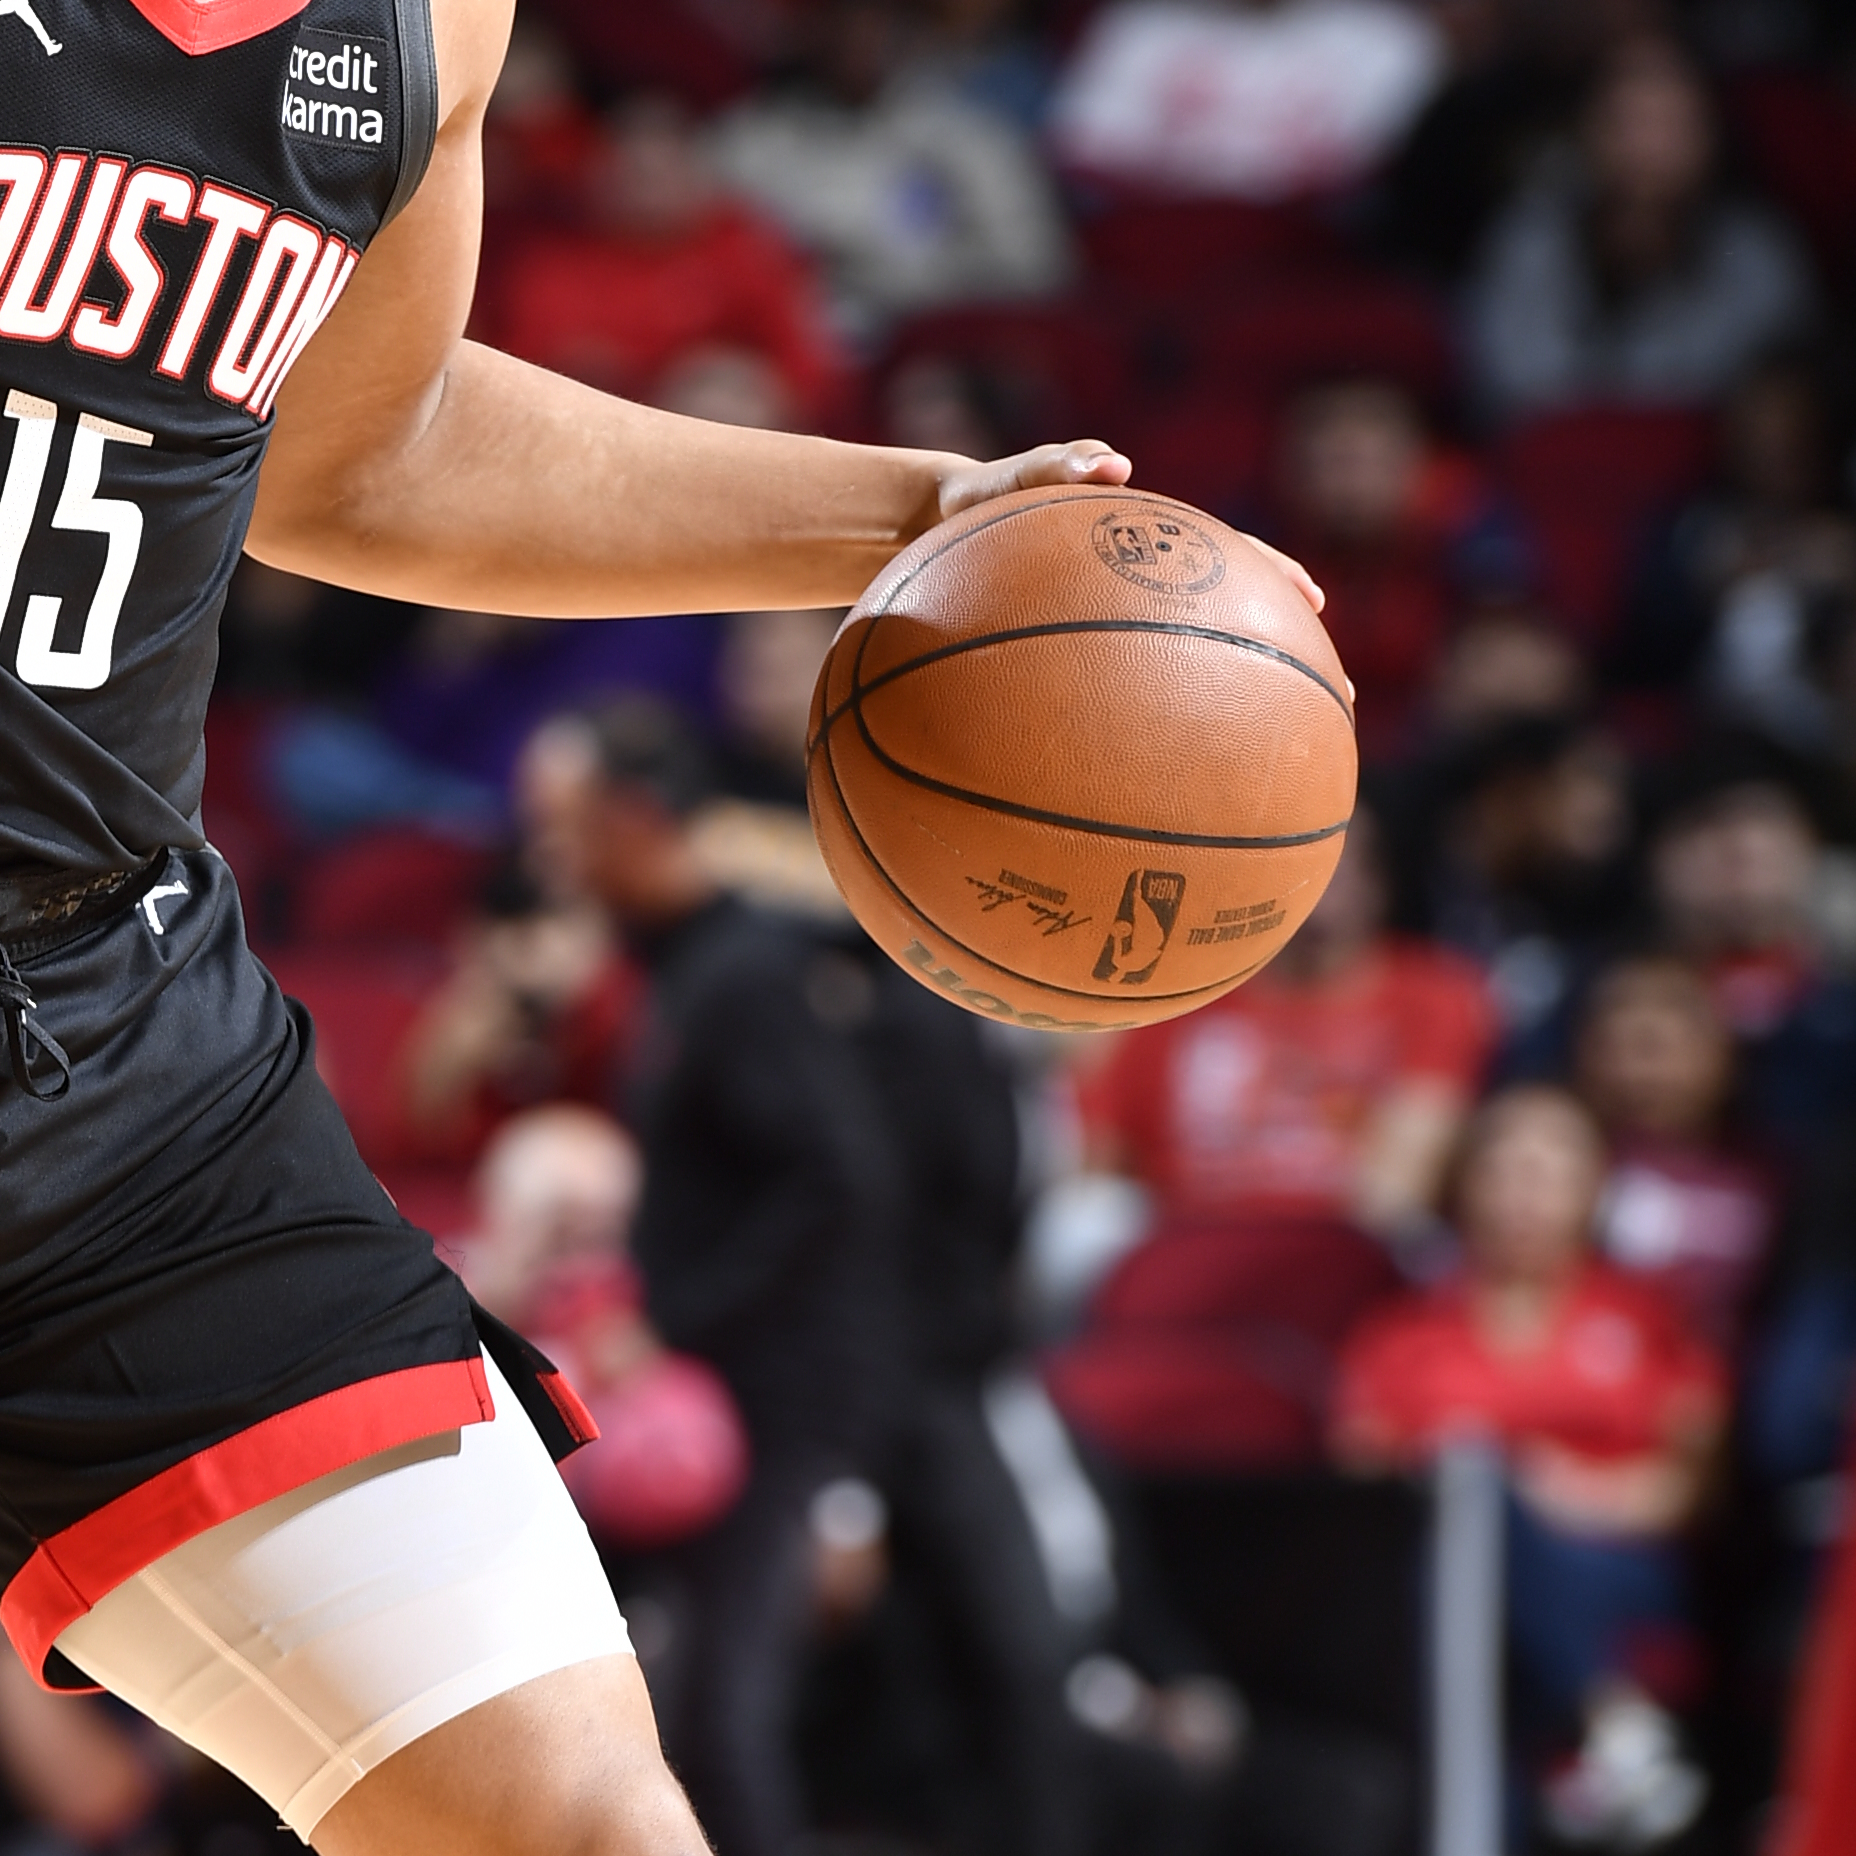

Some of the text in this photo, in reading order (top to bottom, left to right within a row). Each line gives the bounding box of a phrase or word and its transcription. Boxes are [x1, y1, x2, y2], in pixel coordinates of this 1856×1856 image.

[289, 44, 378, 94] credit
[281, 78, 384, 144] karma
[1148, 877, 1180, 900] NBA
